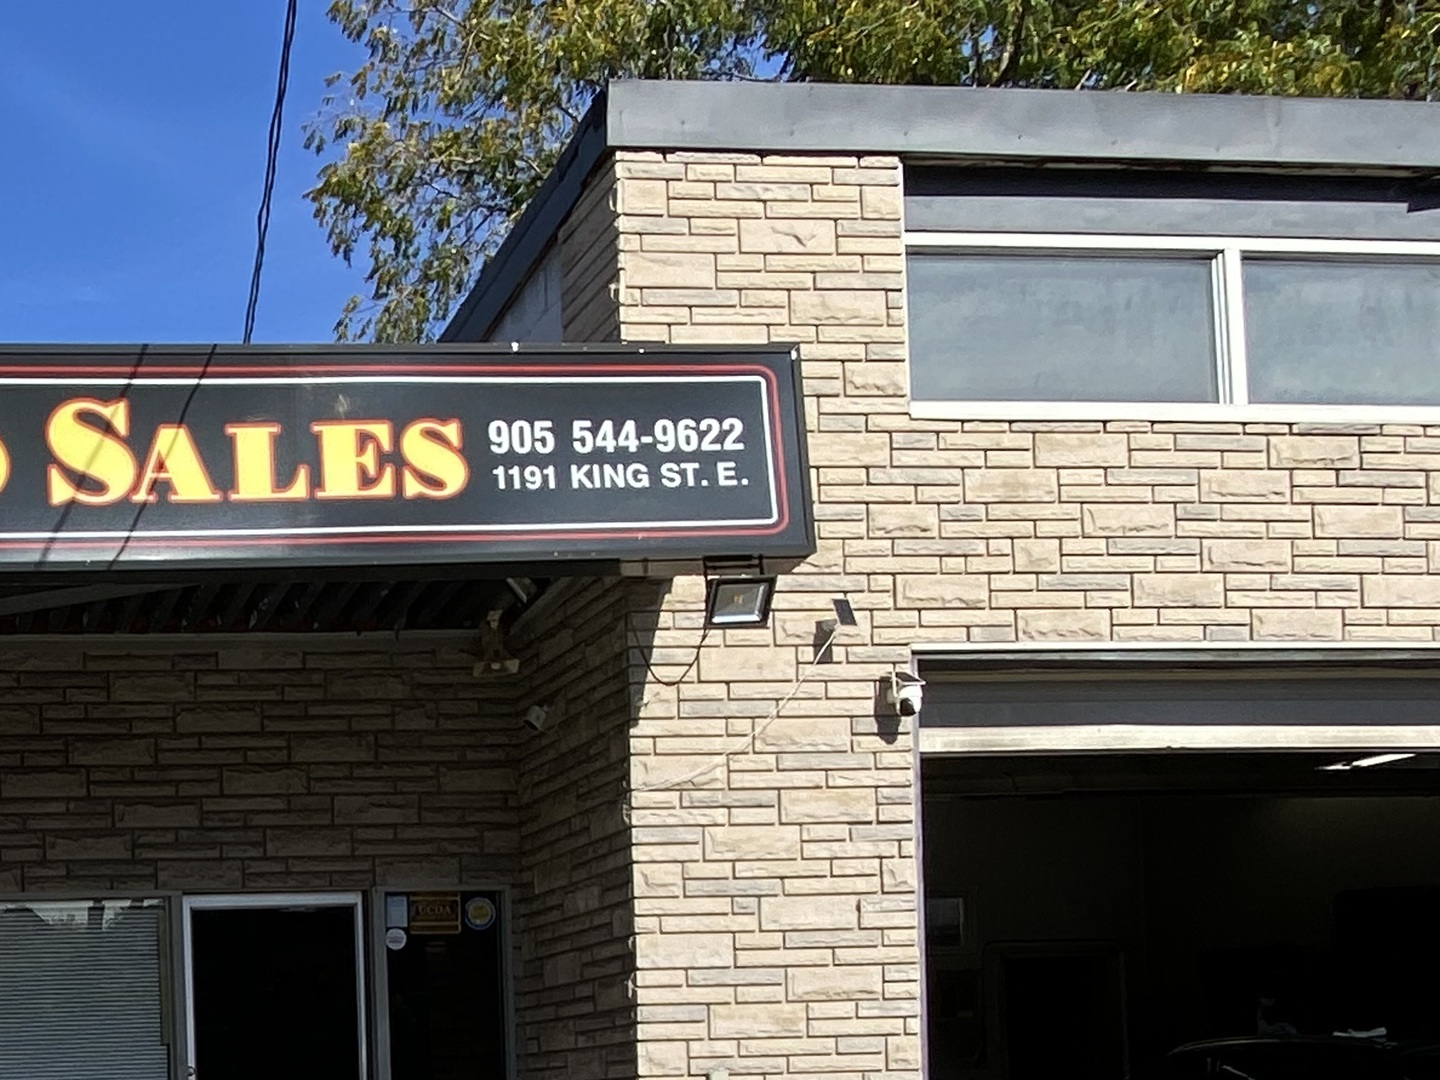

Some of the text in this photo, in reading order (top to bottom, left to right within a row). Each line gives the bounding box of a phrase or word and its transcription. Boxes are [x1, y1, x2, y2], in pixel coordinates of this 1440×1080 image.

[45, 397, 469, 505] SALES
[488, 417, 745, 454] 905 544-9622
[492, 461, 750, 490] 1191 KING ST. E.
